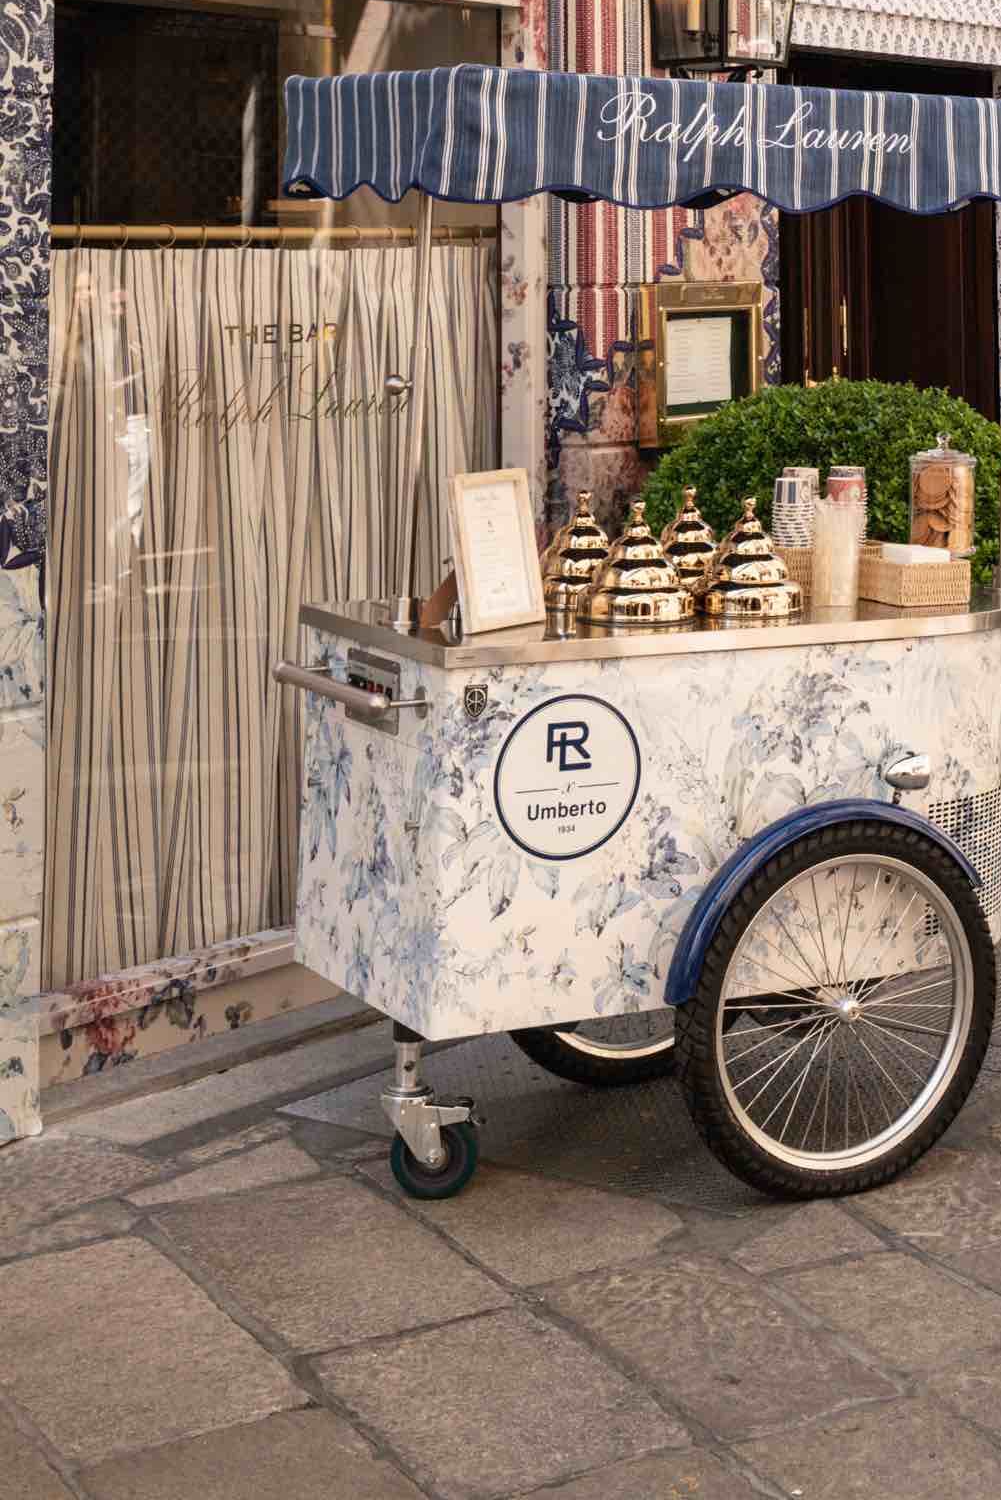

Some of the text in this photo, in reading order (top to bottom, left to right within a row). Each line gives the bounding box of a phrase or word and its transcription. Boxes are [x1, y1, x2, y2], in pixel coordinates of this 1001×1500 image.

[597, 91, 913, 163] Ralph Lauren
[225, 323, 278, 345] THE
[546, 721, 592, 772] RL
[527, 800, 607, 821] Umberto
